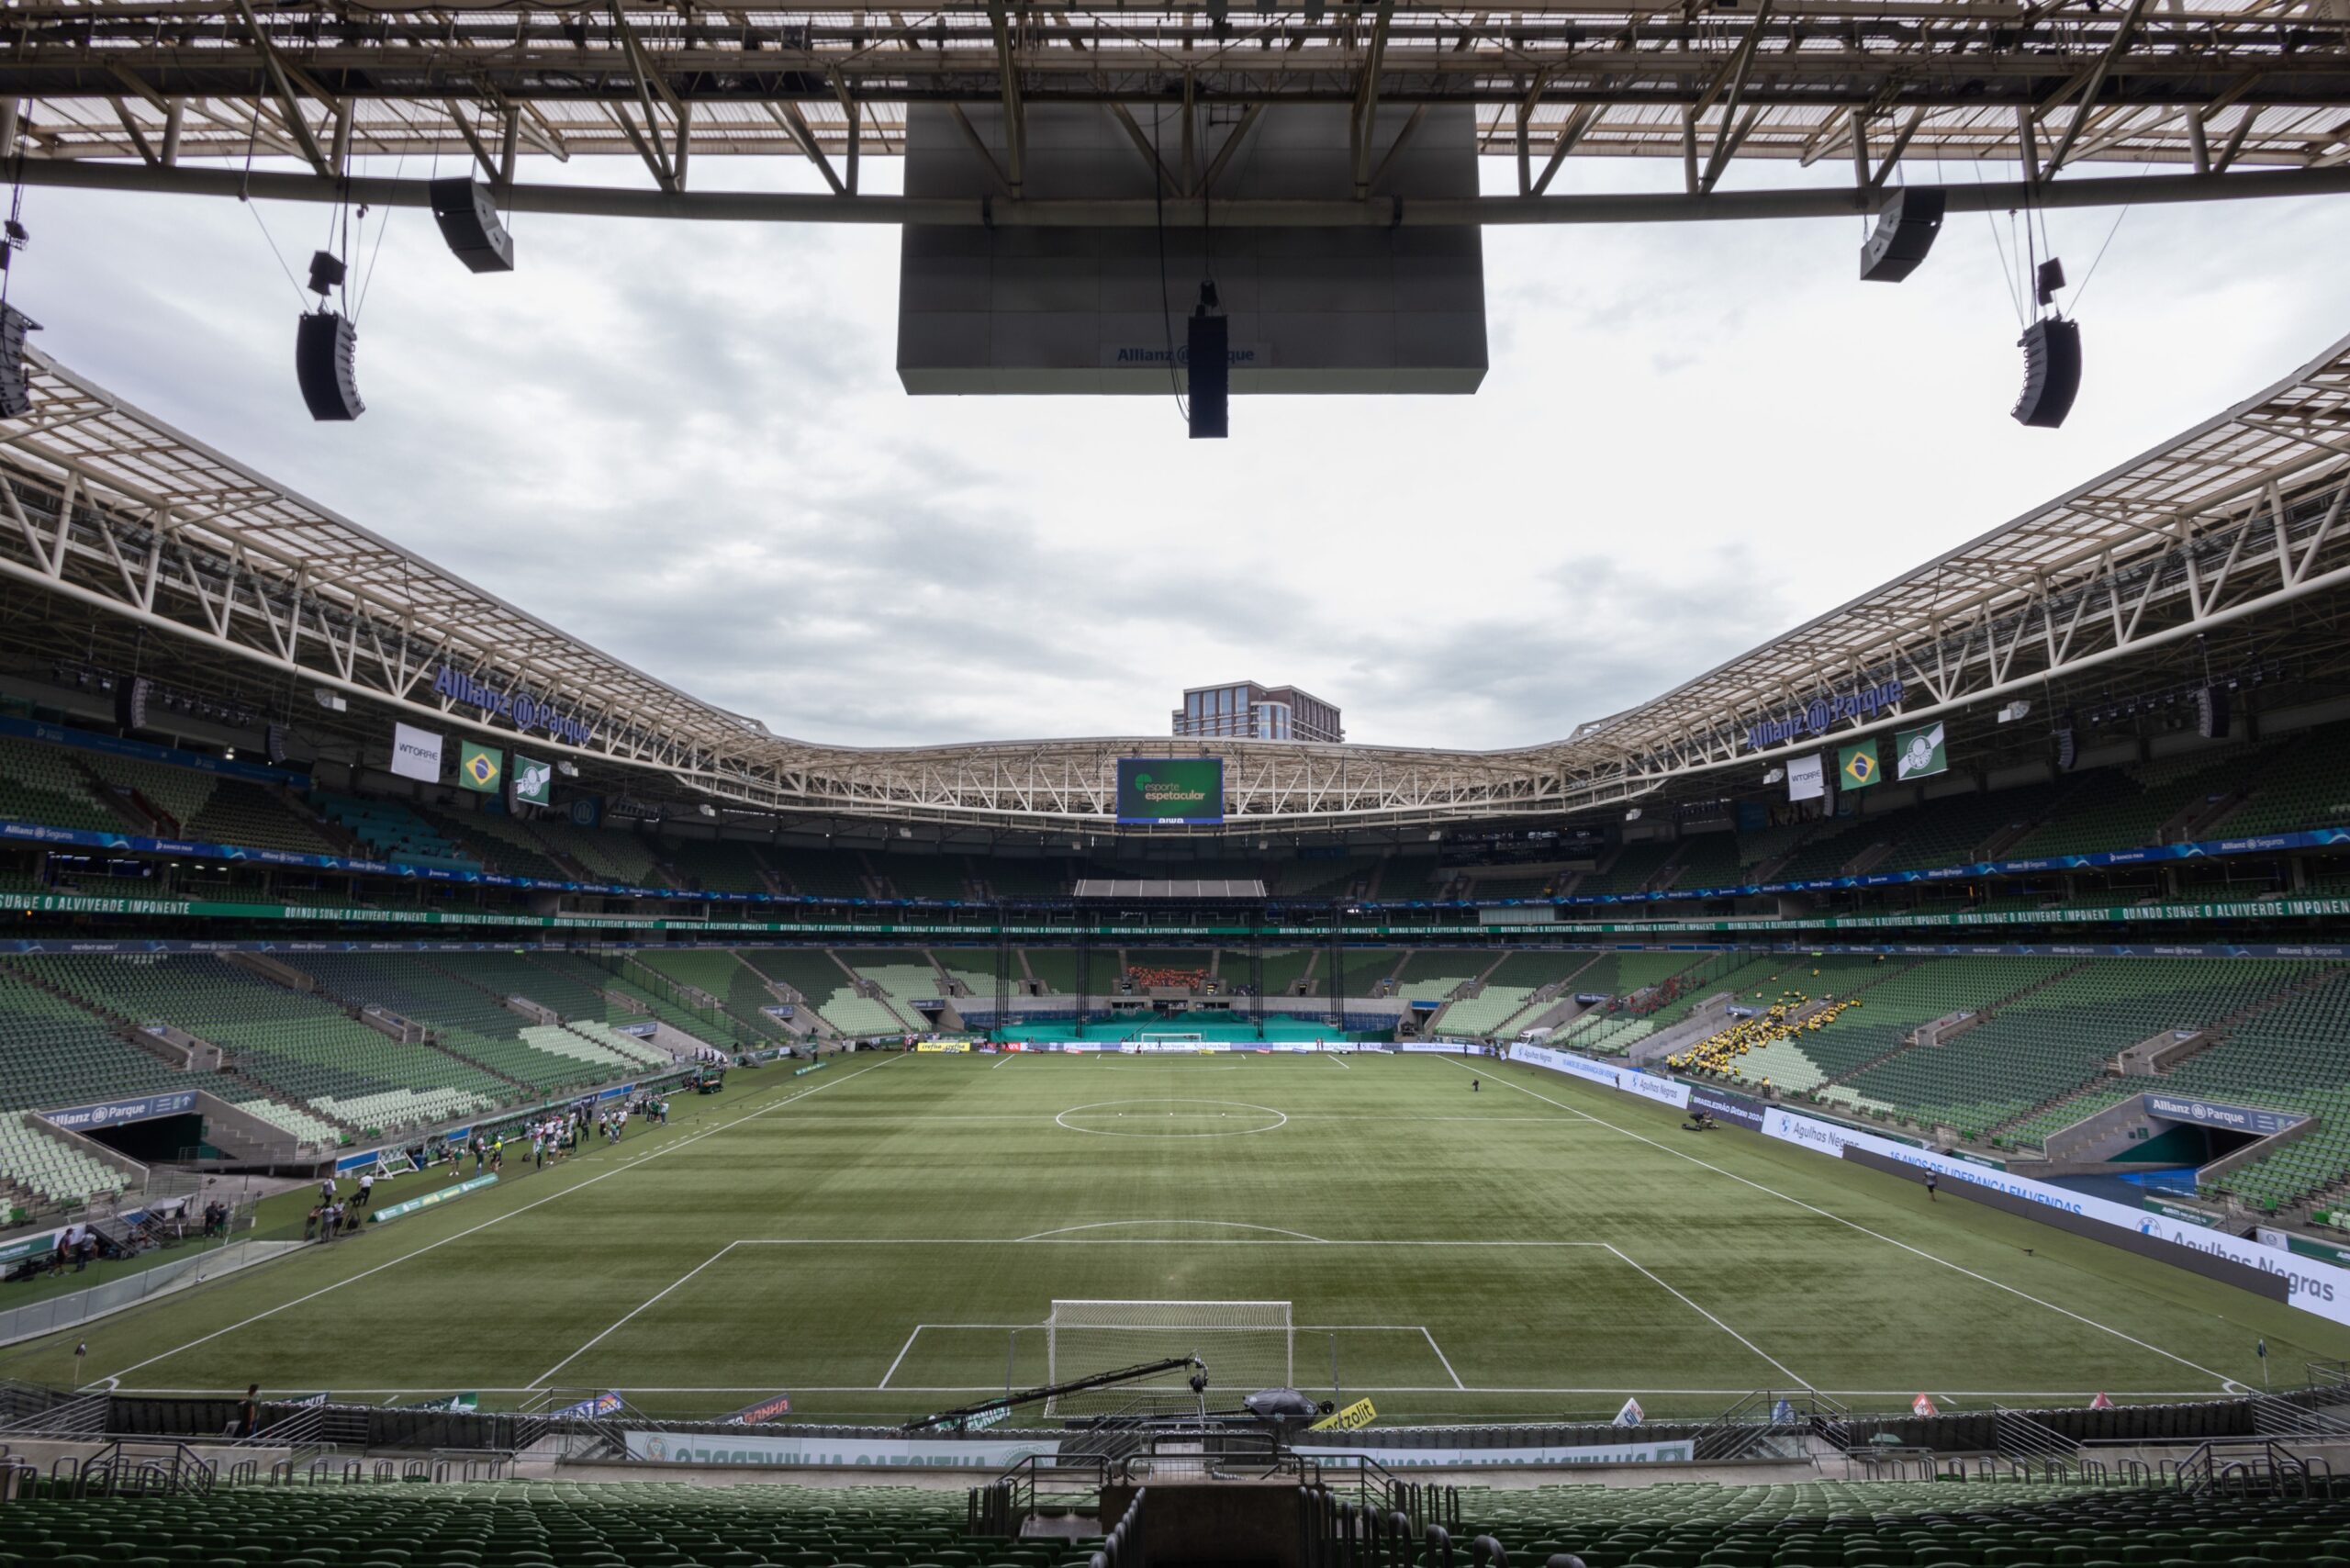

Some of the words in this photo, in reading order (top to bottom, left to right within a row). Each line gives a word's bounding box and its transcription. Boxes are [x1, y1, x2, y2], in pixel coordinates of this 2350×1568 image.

[1116, 347, 1172, 363] Allianz
[434, 666, 511, 716] Allianz
[539, 705, 591, 745] Parque
[1746, 716, 1805, 749] Allianz
[1832, 680, 1904, 721] Parque
[398, 742, 438, 761] WTORRE
[1791, 769, 1821, 783] WTORRE
[1145, 782, 1180, 792] esporte
[1145, 789, 1205, 801] espetacular
[5, 824, 35, 836] Allianz
[45, 829, 73, 840] Seguros
[2221, 841, 2247, 852] Allianz
[2256, 837, 2285, 849] Seguros
[45, 896, 52, 909] O
[58, 896, 125, 912] ALVIVERDE
[129, 900, 190, 914] IMPONENTE
[2122, 905, 2163, 920] QUANDO
[2165, 903, 2200, 919] SURGE
[2205, 903, 2211, 917] O
[2216, 901, 2284, 916] ALVIVERDE
[285, 907, 317, 919] QUANDO
[319, 908, 343, 920] SURGE
[352, 909, 390, 922] ALVIVERDE
[392, 911, 428, 924] IMPONENTE
[1985, 912, 2008, 924] SURGE
[2018, 911, 2063, 923] ALVIVERDE
[2154, 946, 2177, 955] Allianz
[2277, 946, 2301, 956] Allianz
[1639, 1079, 1661, 1092] Agulhas
[1660, 1084, 1679, 1099] Negras
[109, 1104, 146, 1119] Parque
[1748, 1112, 1763, 1122] 2024
[2153, 1099, 2191, 1114] Allianz
[2207, 1107, 2244, 1125] Parque
[1793, 1122, 1827, 1143] Agulhas
